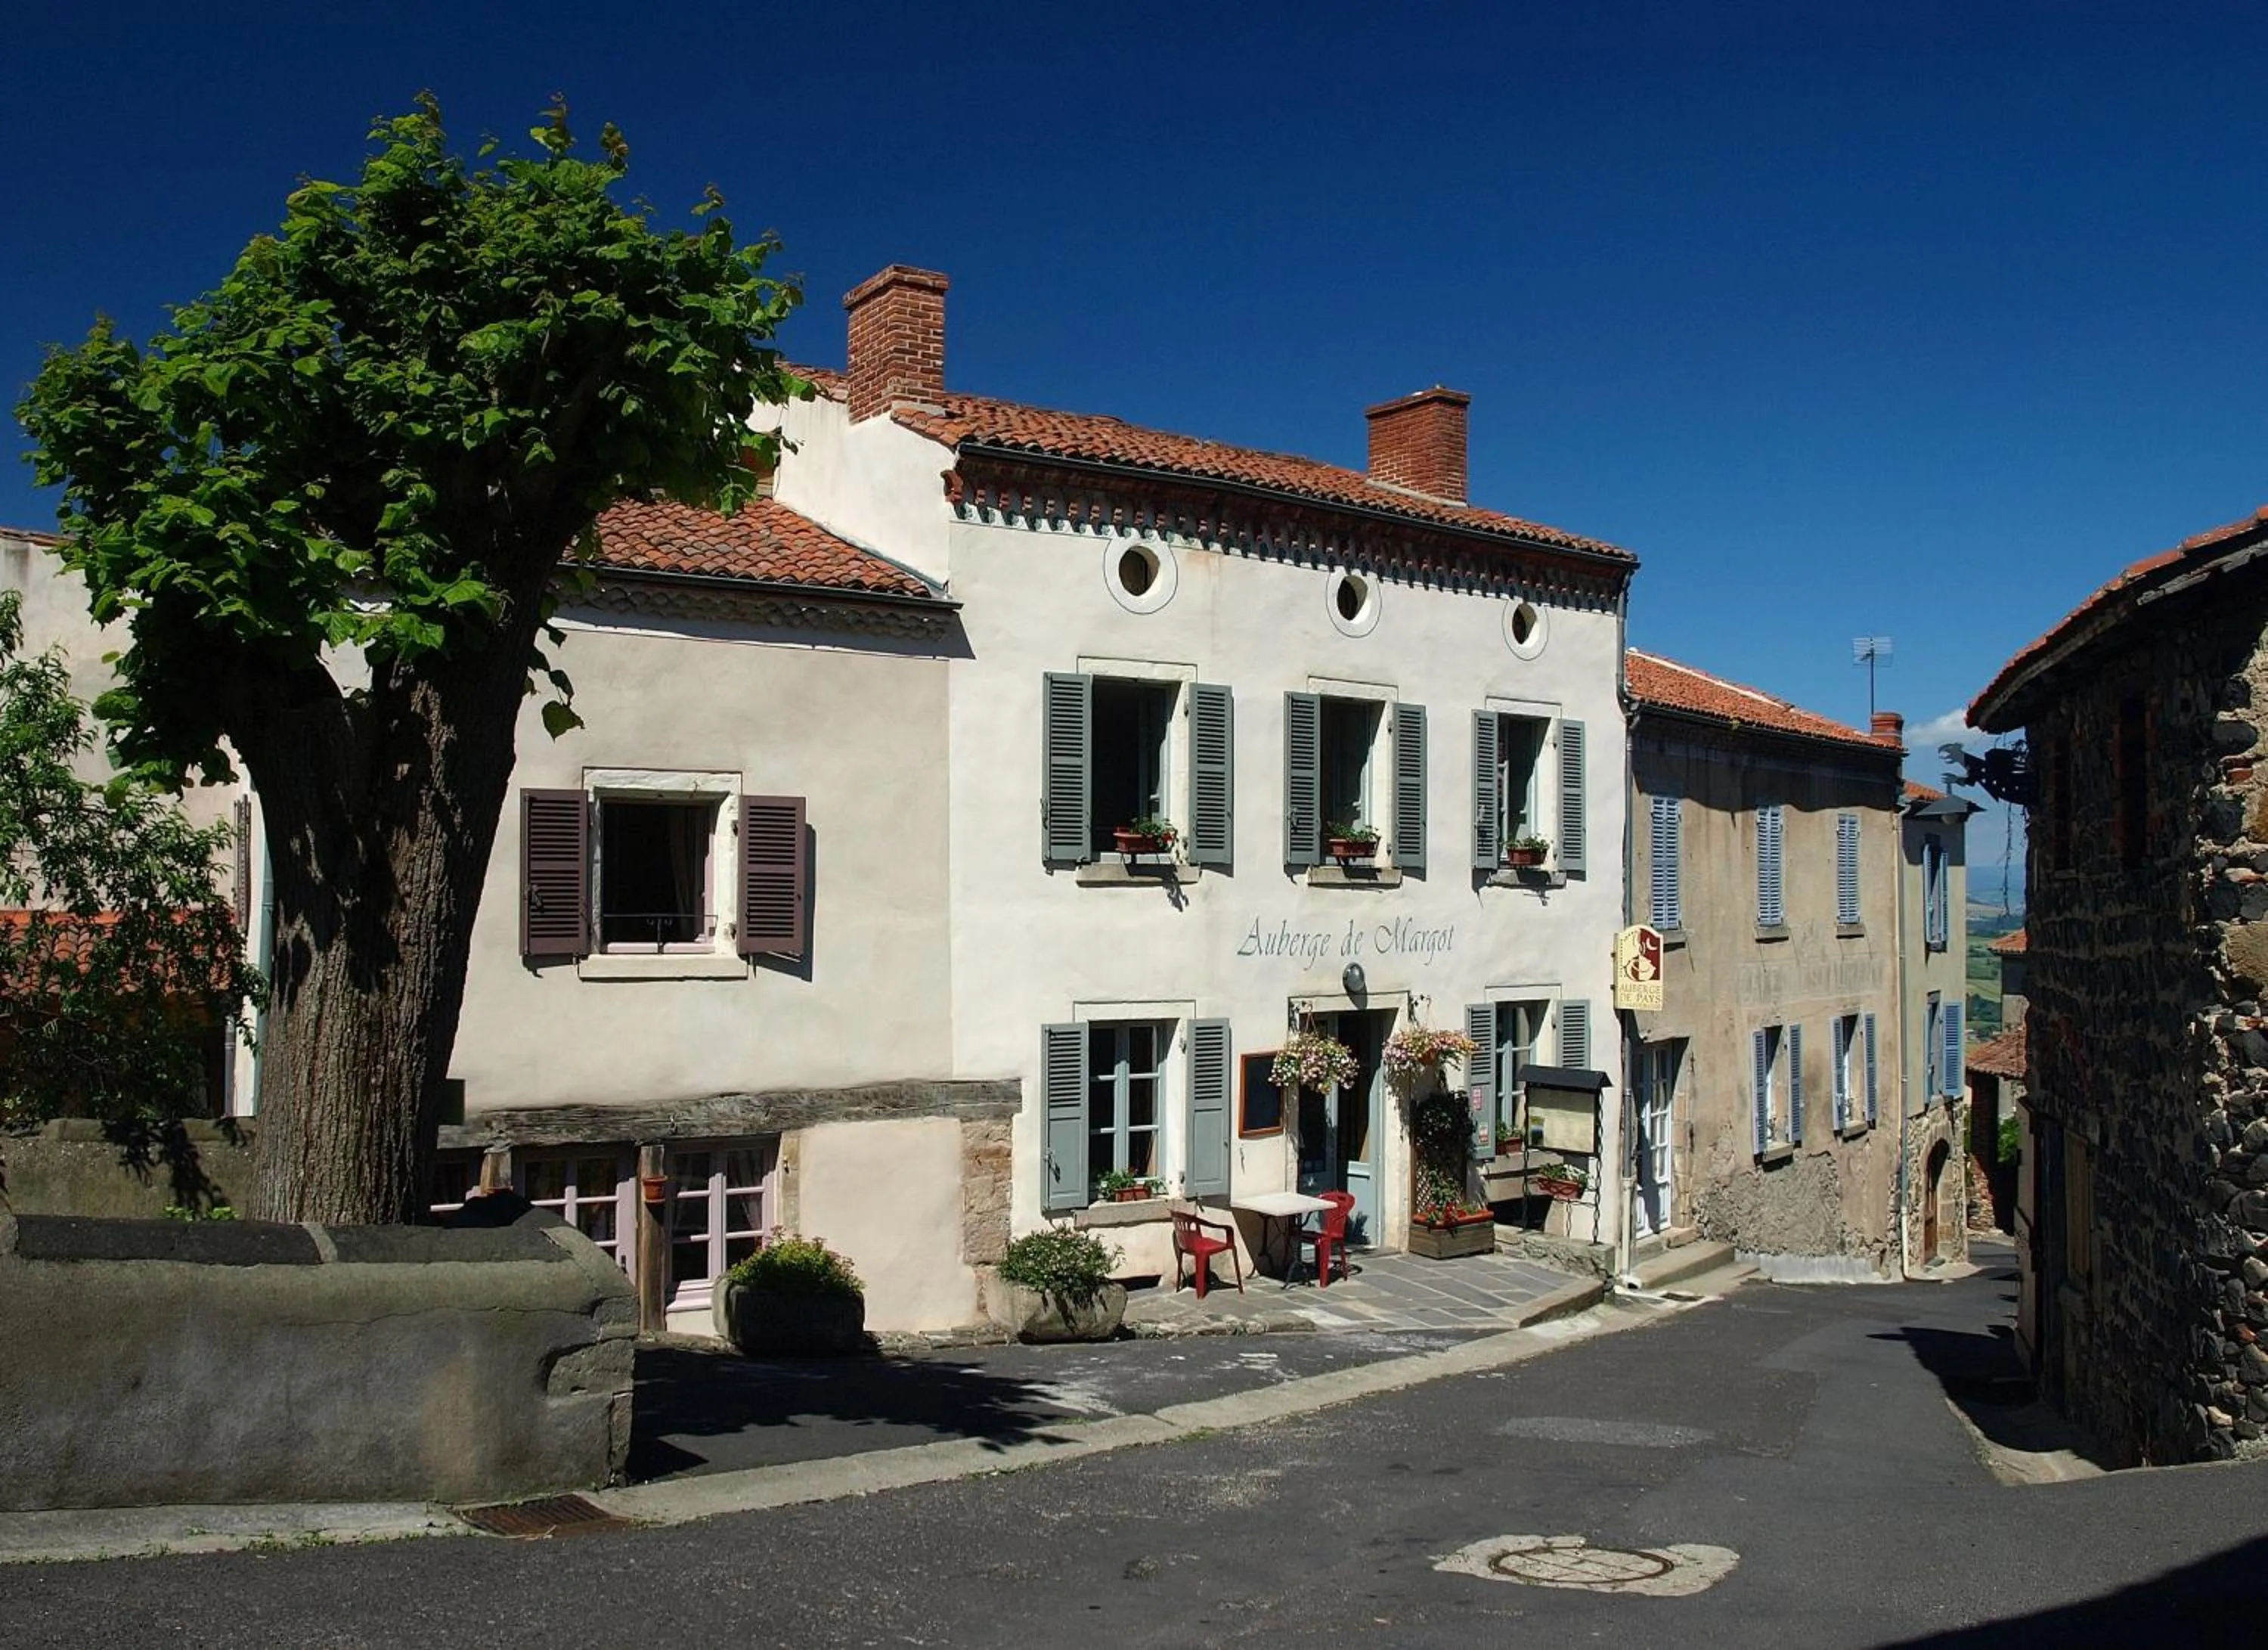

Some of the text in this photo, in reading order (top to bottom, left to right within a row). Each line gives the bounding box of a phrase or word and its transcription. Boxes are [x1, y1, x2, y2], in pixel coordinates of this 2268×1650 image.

[1237, 915, 1454, 971] Auberge de Margot
[1619, 983, 1661, 994] AUBERGE
[1620, 993, 1661, 1003] DE PAYS
